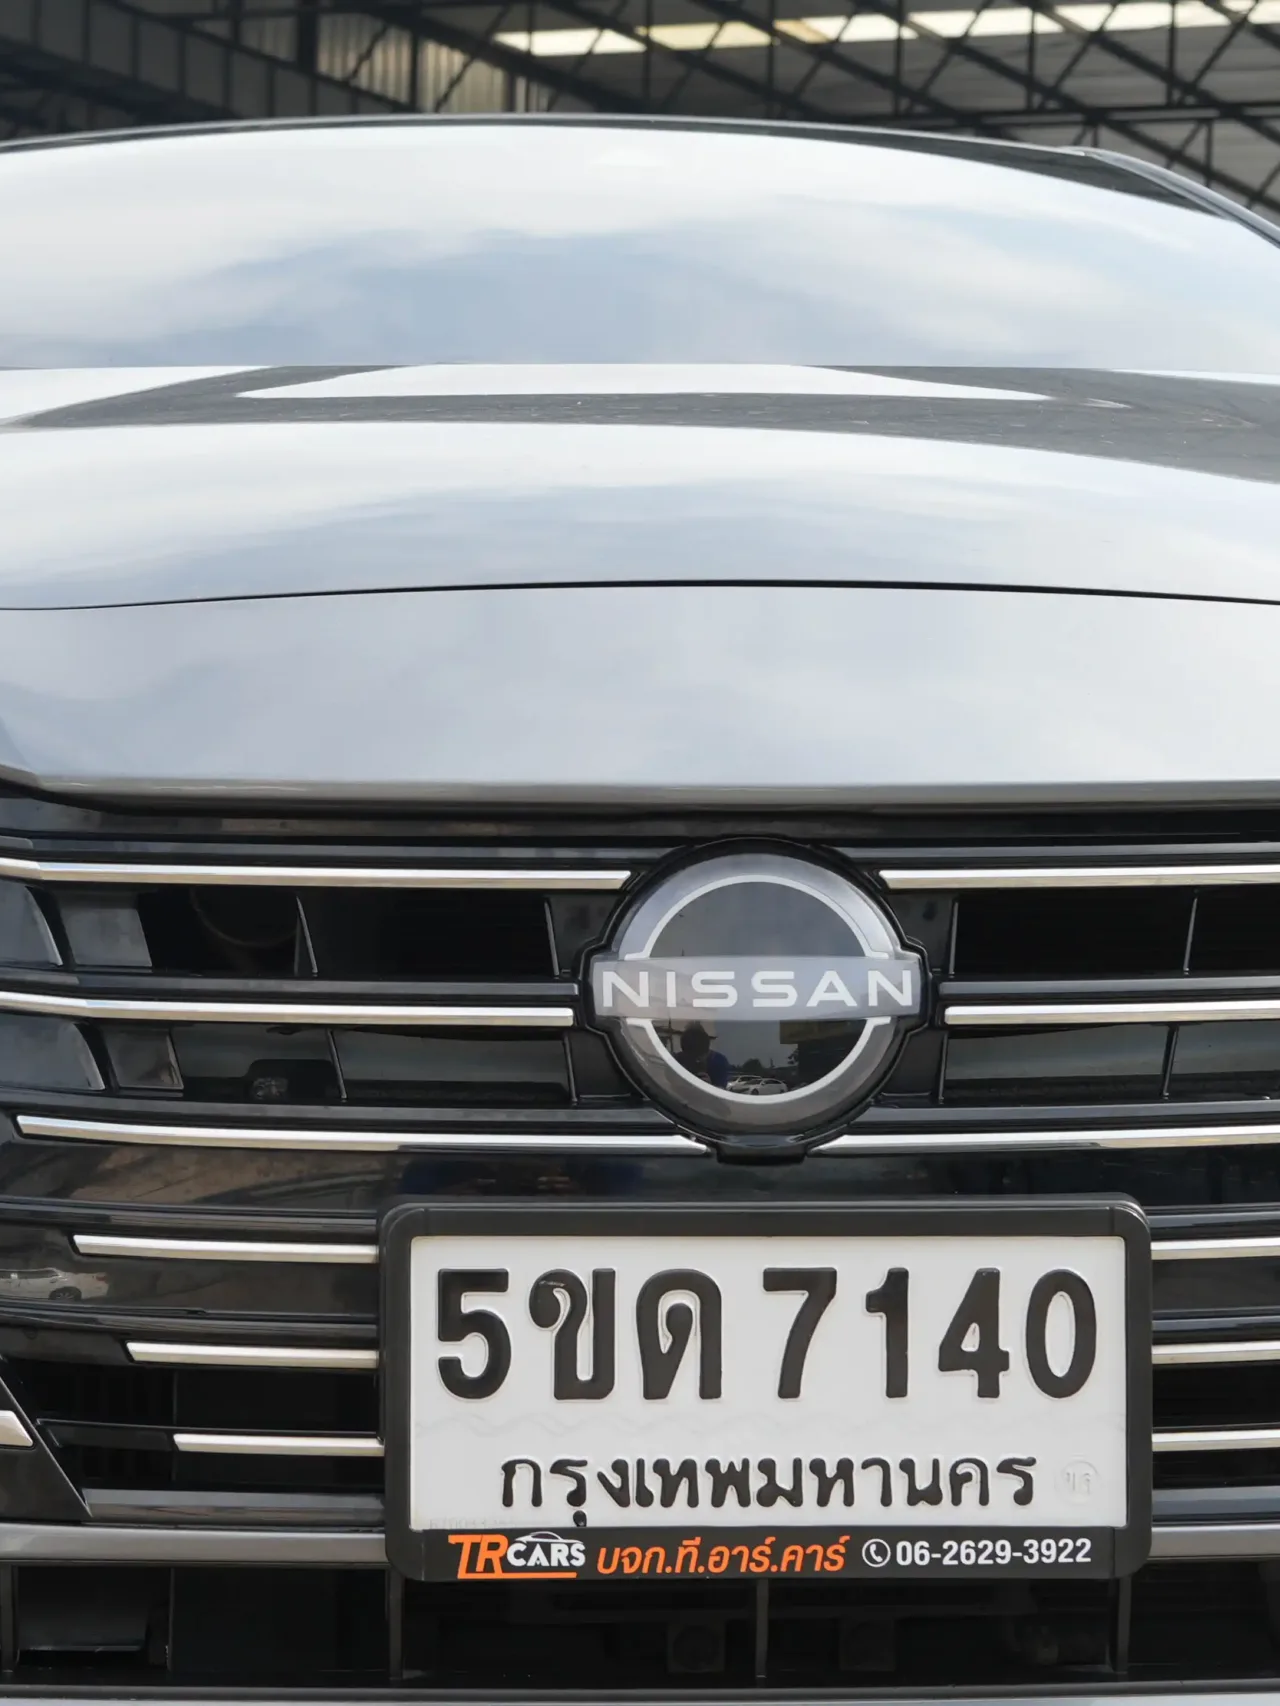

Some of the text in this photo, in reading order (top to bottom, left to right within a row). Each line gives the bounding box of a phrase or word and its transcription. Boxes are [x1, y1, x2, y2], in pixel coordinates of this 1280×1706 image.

[602, 969, 914, 1008] NISSAN
[436, 1266, 1098, 1401] 5ขด 7140
[500, 1456, 1038, 1527] กรุงเทพมหานคร
[506, 1542, 587, 1567] CARS
[596, 1535, 851, 1575] บจก.ที.อาร์.คาร์
[895, 1537, 1093, 1566] 06-2629-3922
